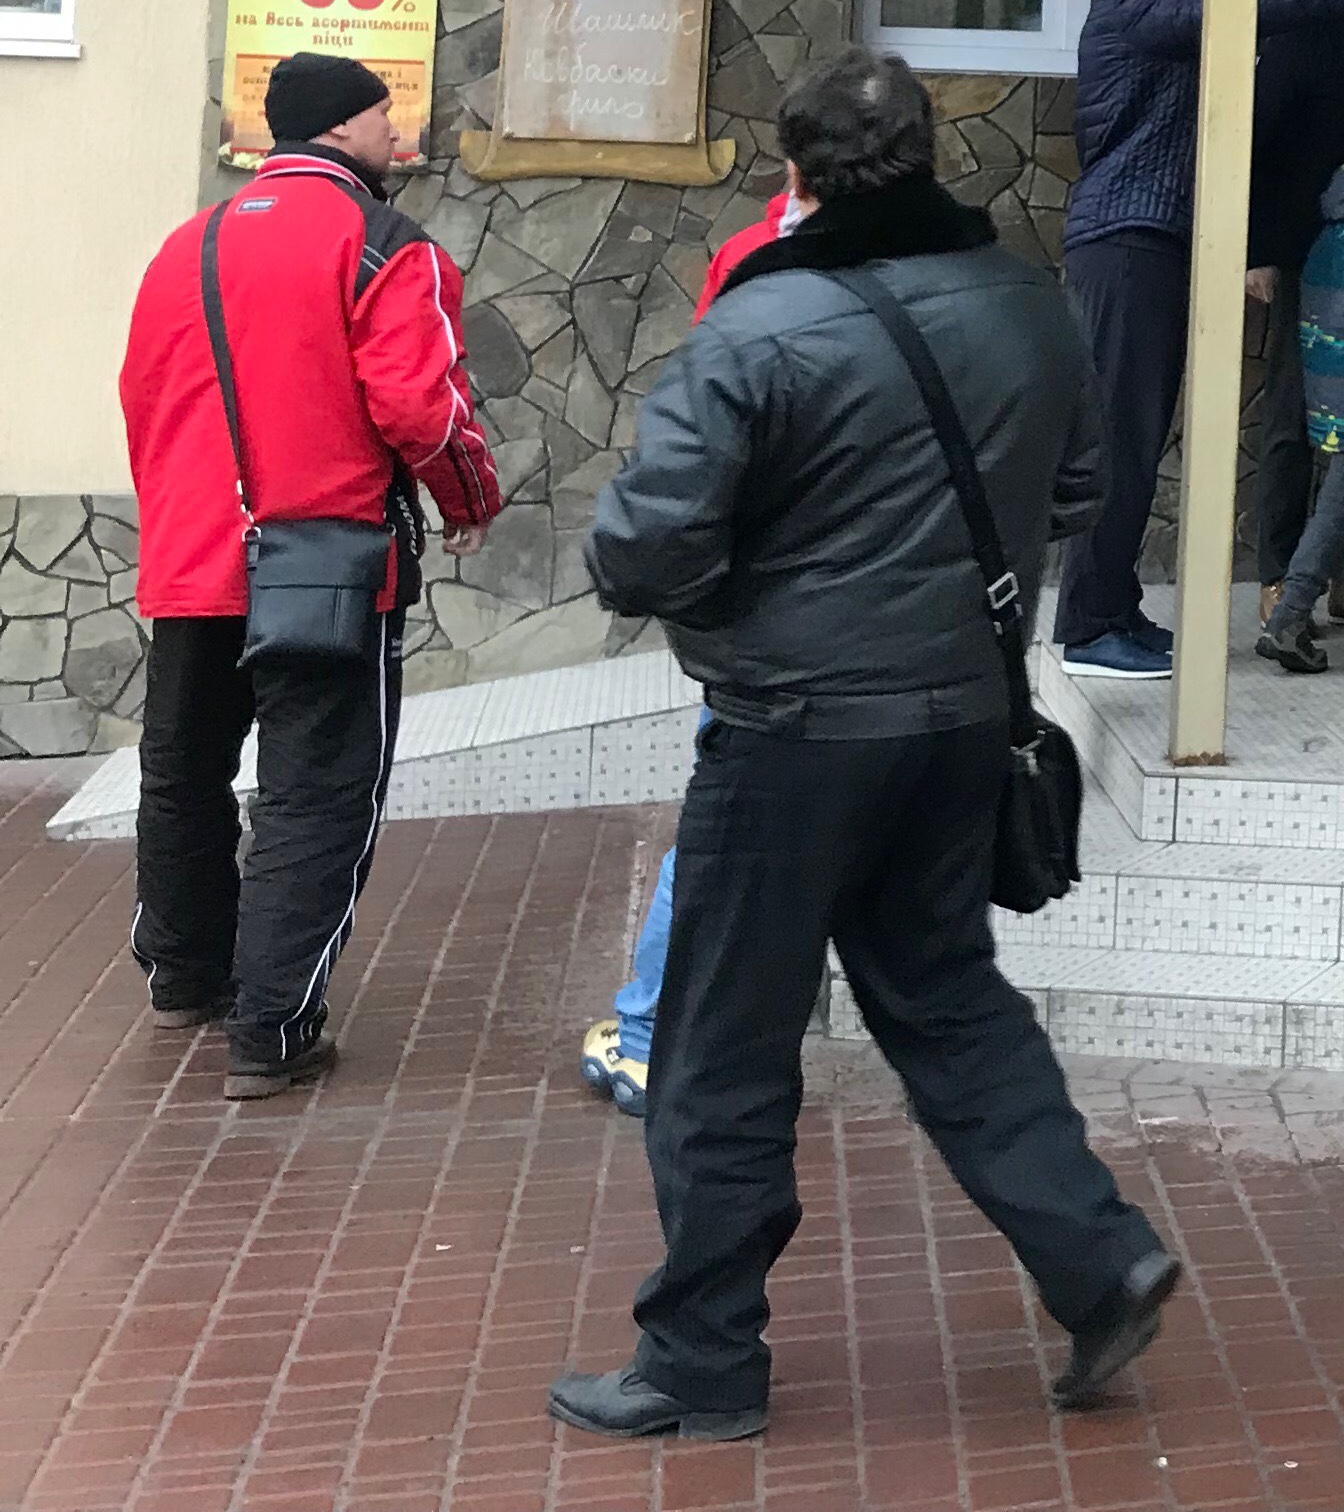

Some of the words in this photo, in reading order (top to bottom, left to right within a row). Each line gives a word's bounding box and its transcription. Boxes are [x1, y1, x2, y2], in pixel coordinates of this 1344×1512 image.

[235, 13, 257, 25] на
[312, 17, 430, 32] асортимент
[312, 31, 354, 47] піци
